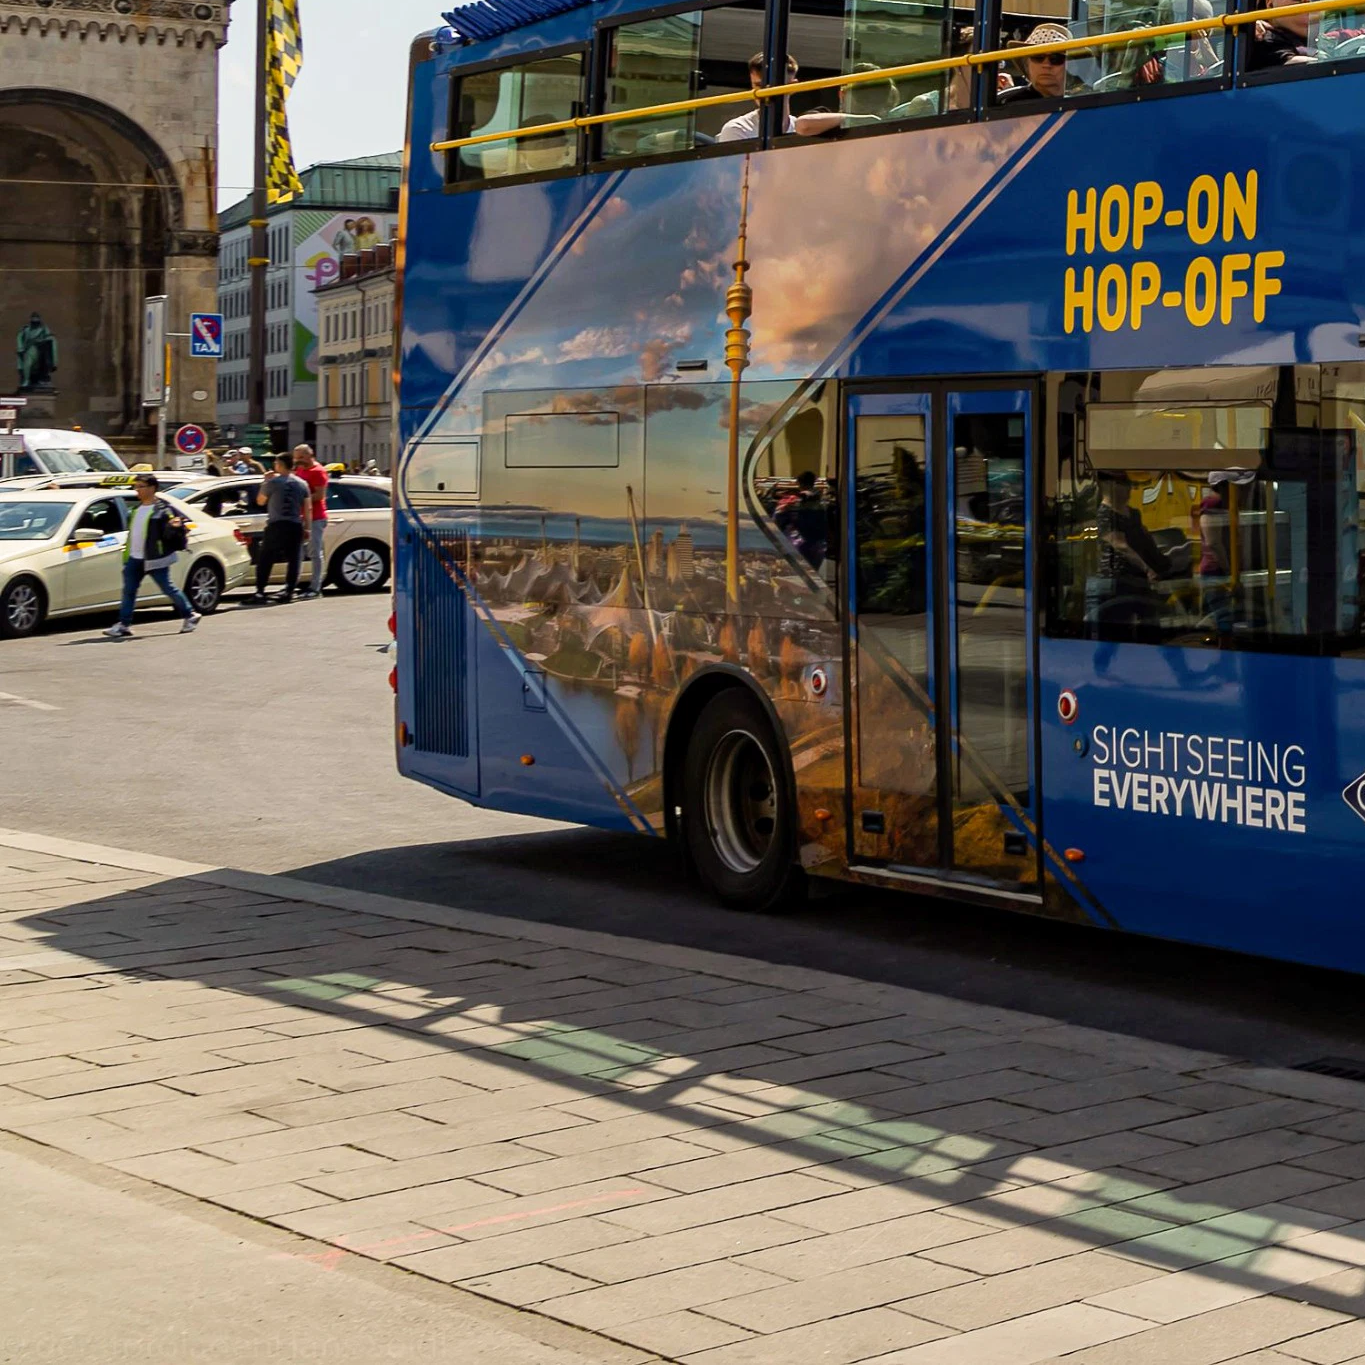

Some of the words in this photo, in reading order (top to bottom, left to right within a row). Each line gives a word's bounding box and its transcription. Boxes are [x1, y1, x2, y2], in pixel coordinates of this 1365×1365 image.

[1065, 169, 1258, 256] HOP-ON
[1063, 250, 1285, 334] HOP-OFF
[1092, 725, 1306, 787] SIGHTSEEING
[1093, 768, 1306, 833] EVERYWHERE
